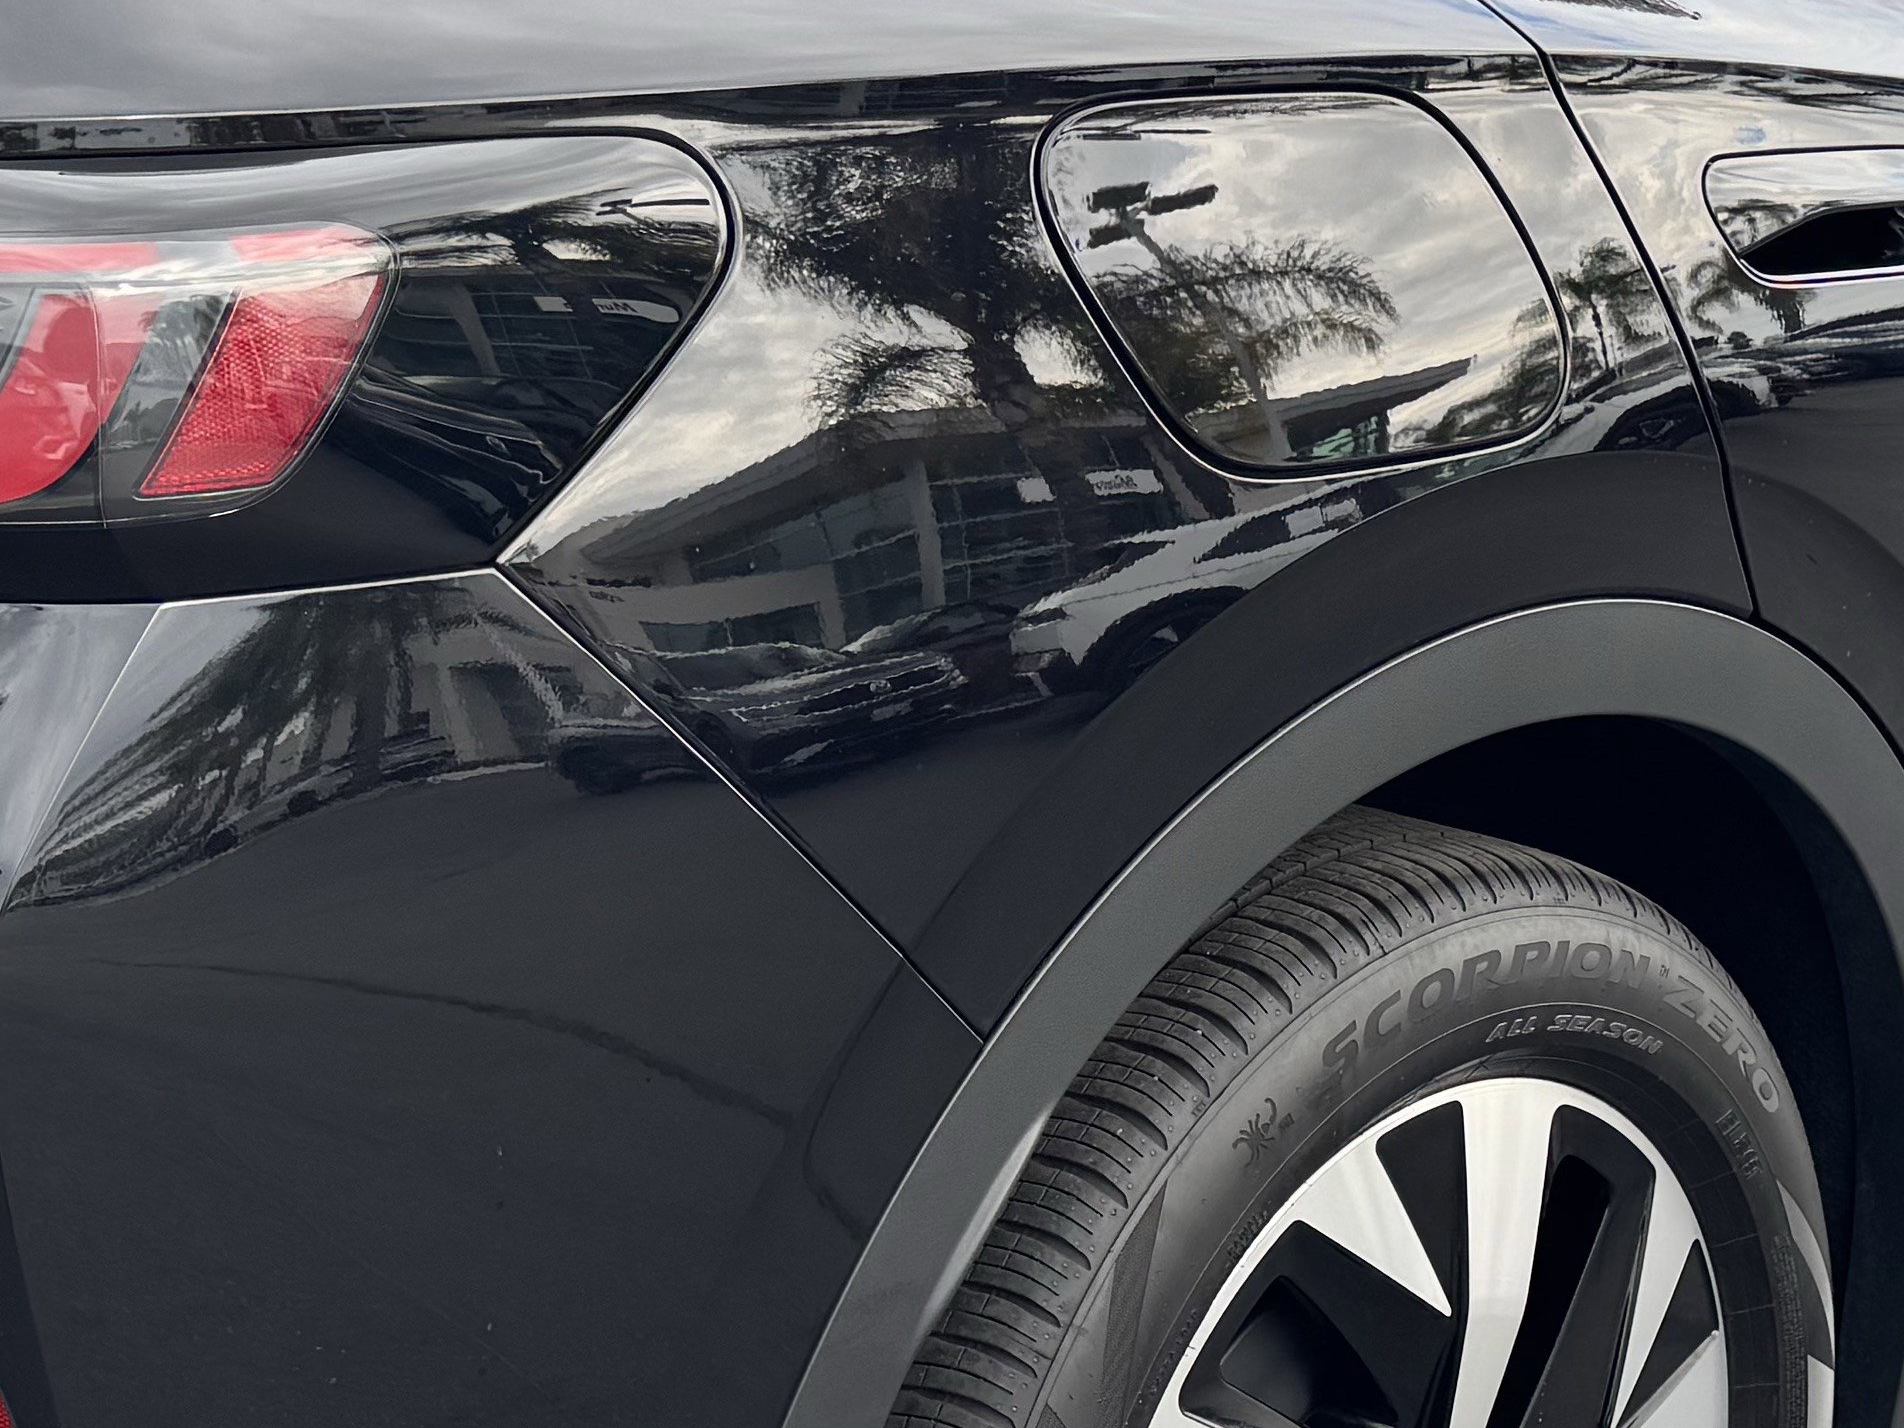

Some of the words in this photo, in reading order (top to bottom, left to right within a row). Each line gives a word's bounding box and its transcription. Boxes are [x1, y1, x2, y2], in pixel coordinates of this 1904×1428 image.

[1321, 939, 1651, 1075] SCORPION
[1661, 976, 1781, 1114] ZERO
[1485, 1013, 1537, 1044] ALL
[1546, 1012, 1664, 1056] SEASON
